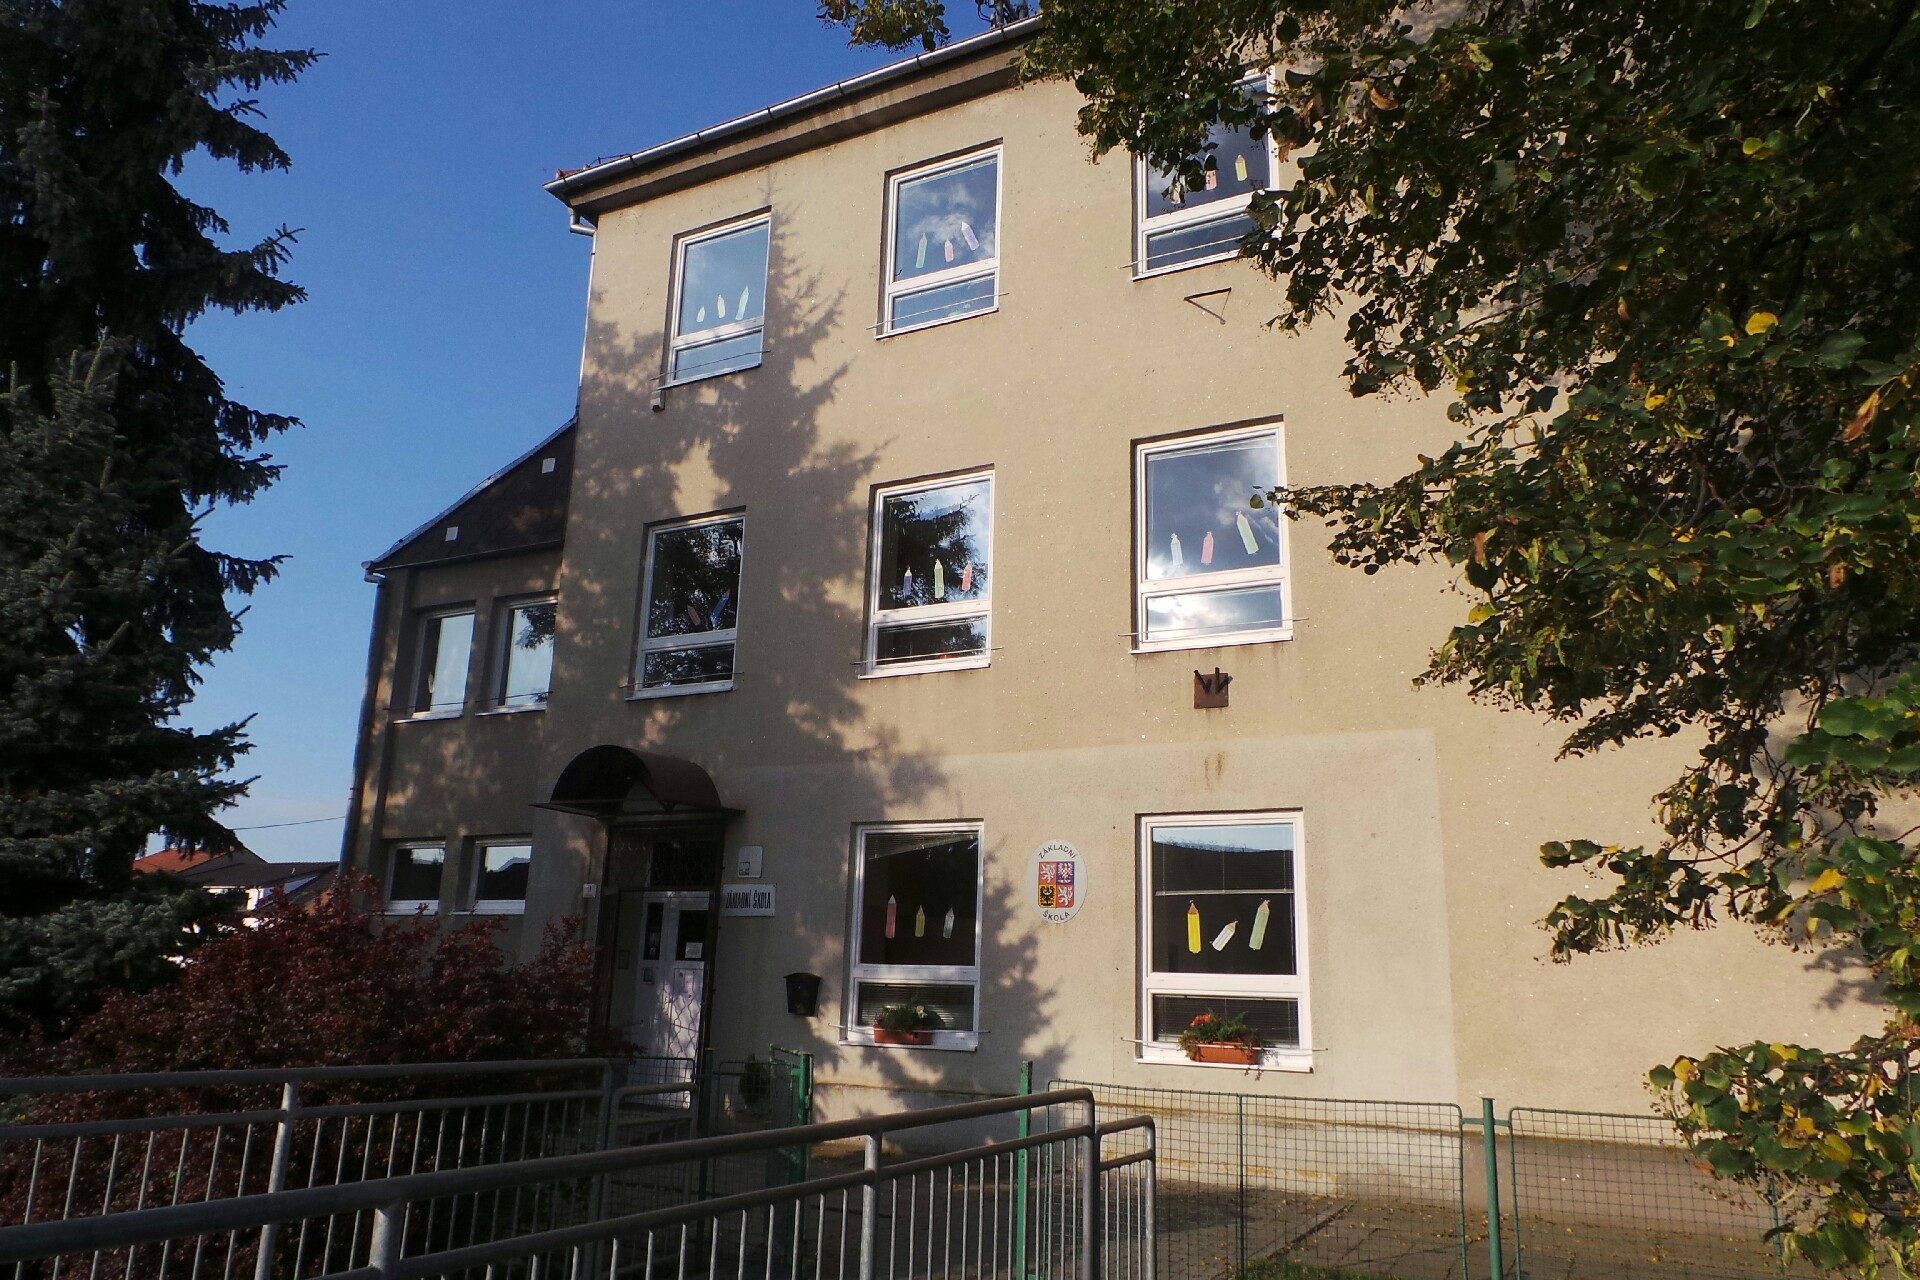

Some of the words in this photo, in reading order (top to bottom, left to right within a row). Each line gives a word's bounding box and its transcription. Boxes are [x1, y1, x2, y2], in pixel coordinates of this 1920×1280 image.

[1038, 844, 1078, 859] ZÁKLADNÍ
[726, 890, 752, 909] ZÁKLADNÍ
[753, 890, 771, 909] ŠKOLA
[1043, 909, 1070, 921] ŠKOLA
